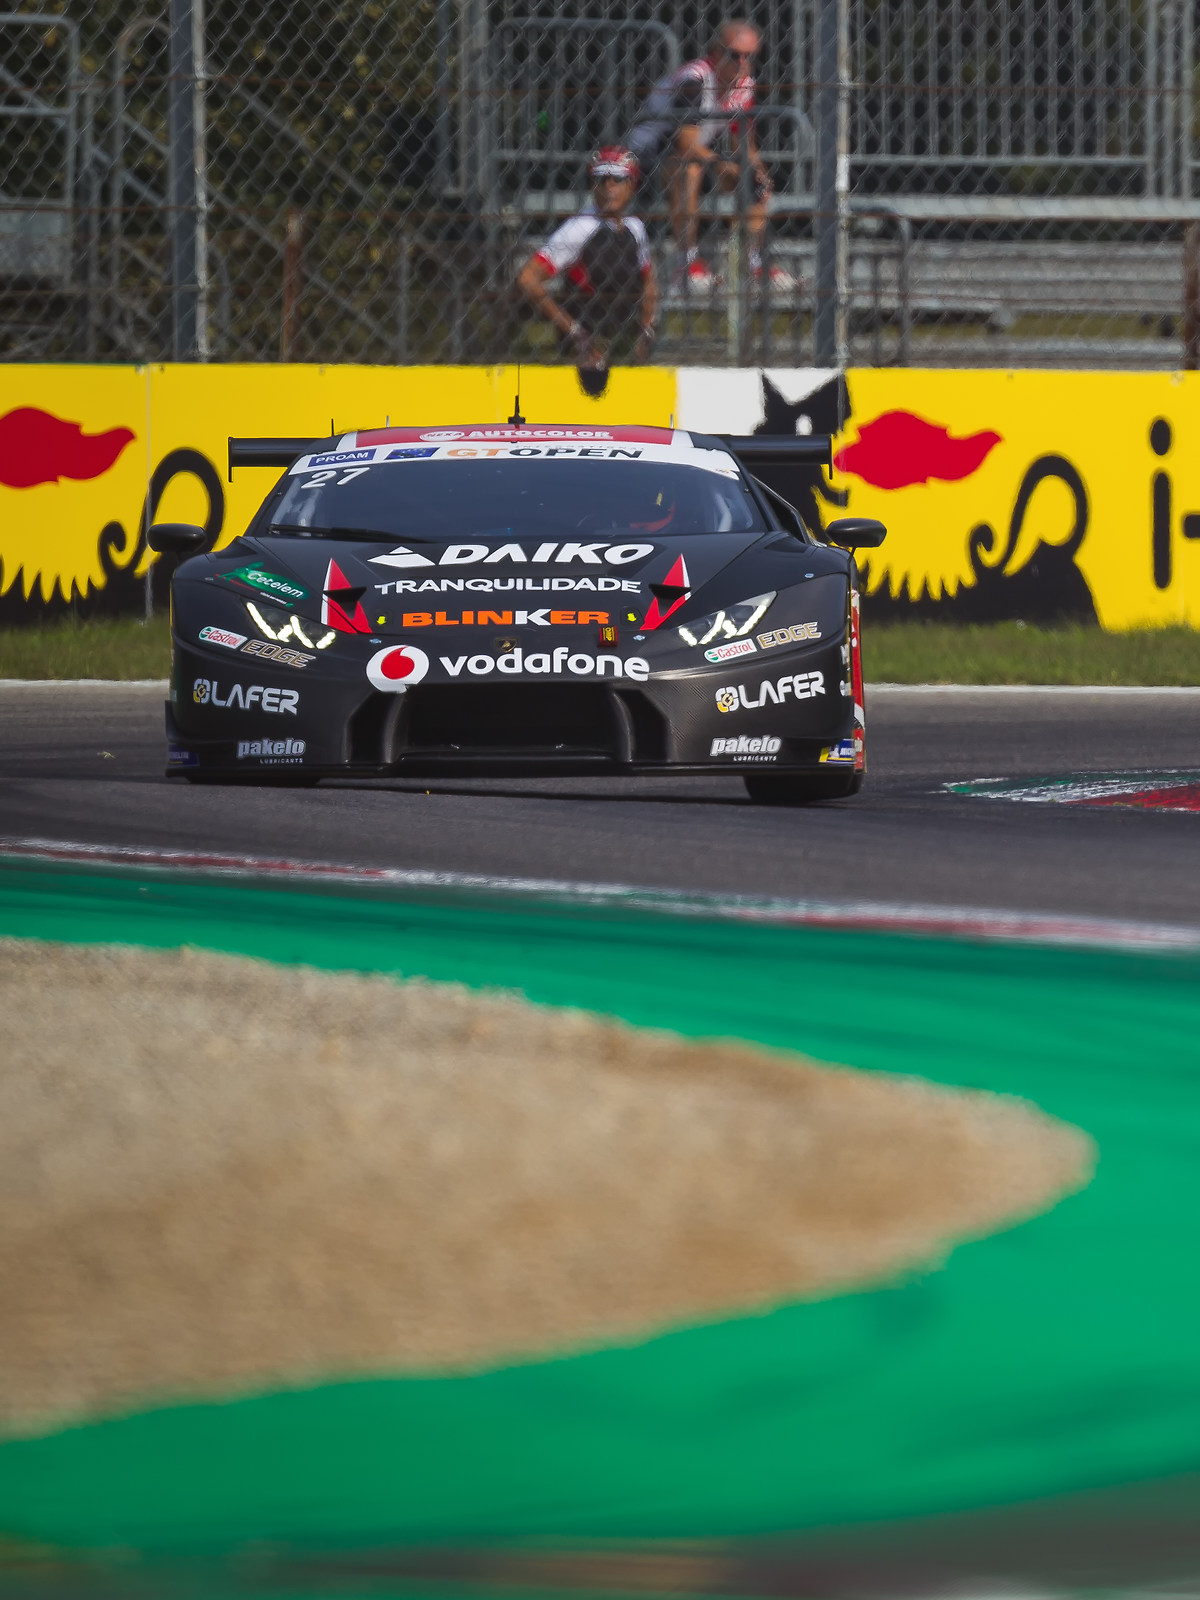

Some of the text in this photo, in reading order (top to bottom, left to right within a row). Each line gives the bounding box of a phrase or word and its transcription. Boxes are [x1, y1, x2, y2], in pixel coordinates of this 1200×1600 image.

[468, 430, 613, 439] AUTOCOLOR
[315, 451, 369, 464] PROAM
[301, 467, 370, 488] 27
[438, 543, 655, 565] DAIKO
[247, 572, 304, 598] Cetelem
[374, 577, 642, 594] TRANQUILIDADE
[402, 609, 609, 627] BLINKER
[208, 630, 316, 668] Castrol EDGE
[717, 622, 822, 659] Castrol EDGE
[439, 647, 650, 682] vodafone
[237, 738, 306, 759] pakelo
[710, 735, 782, 756] pakelo
